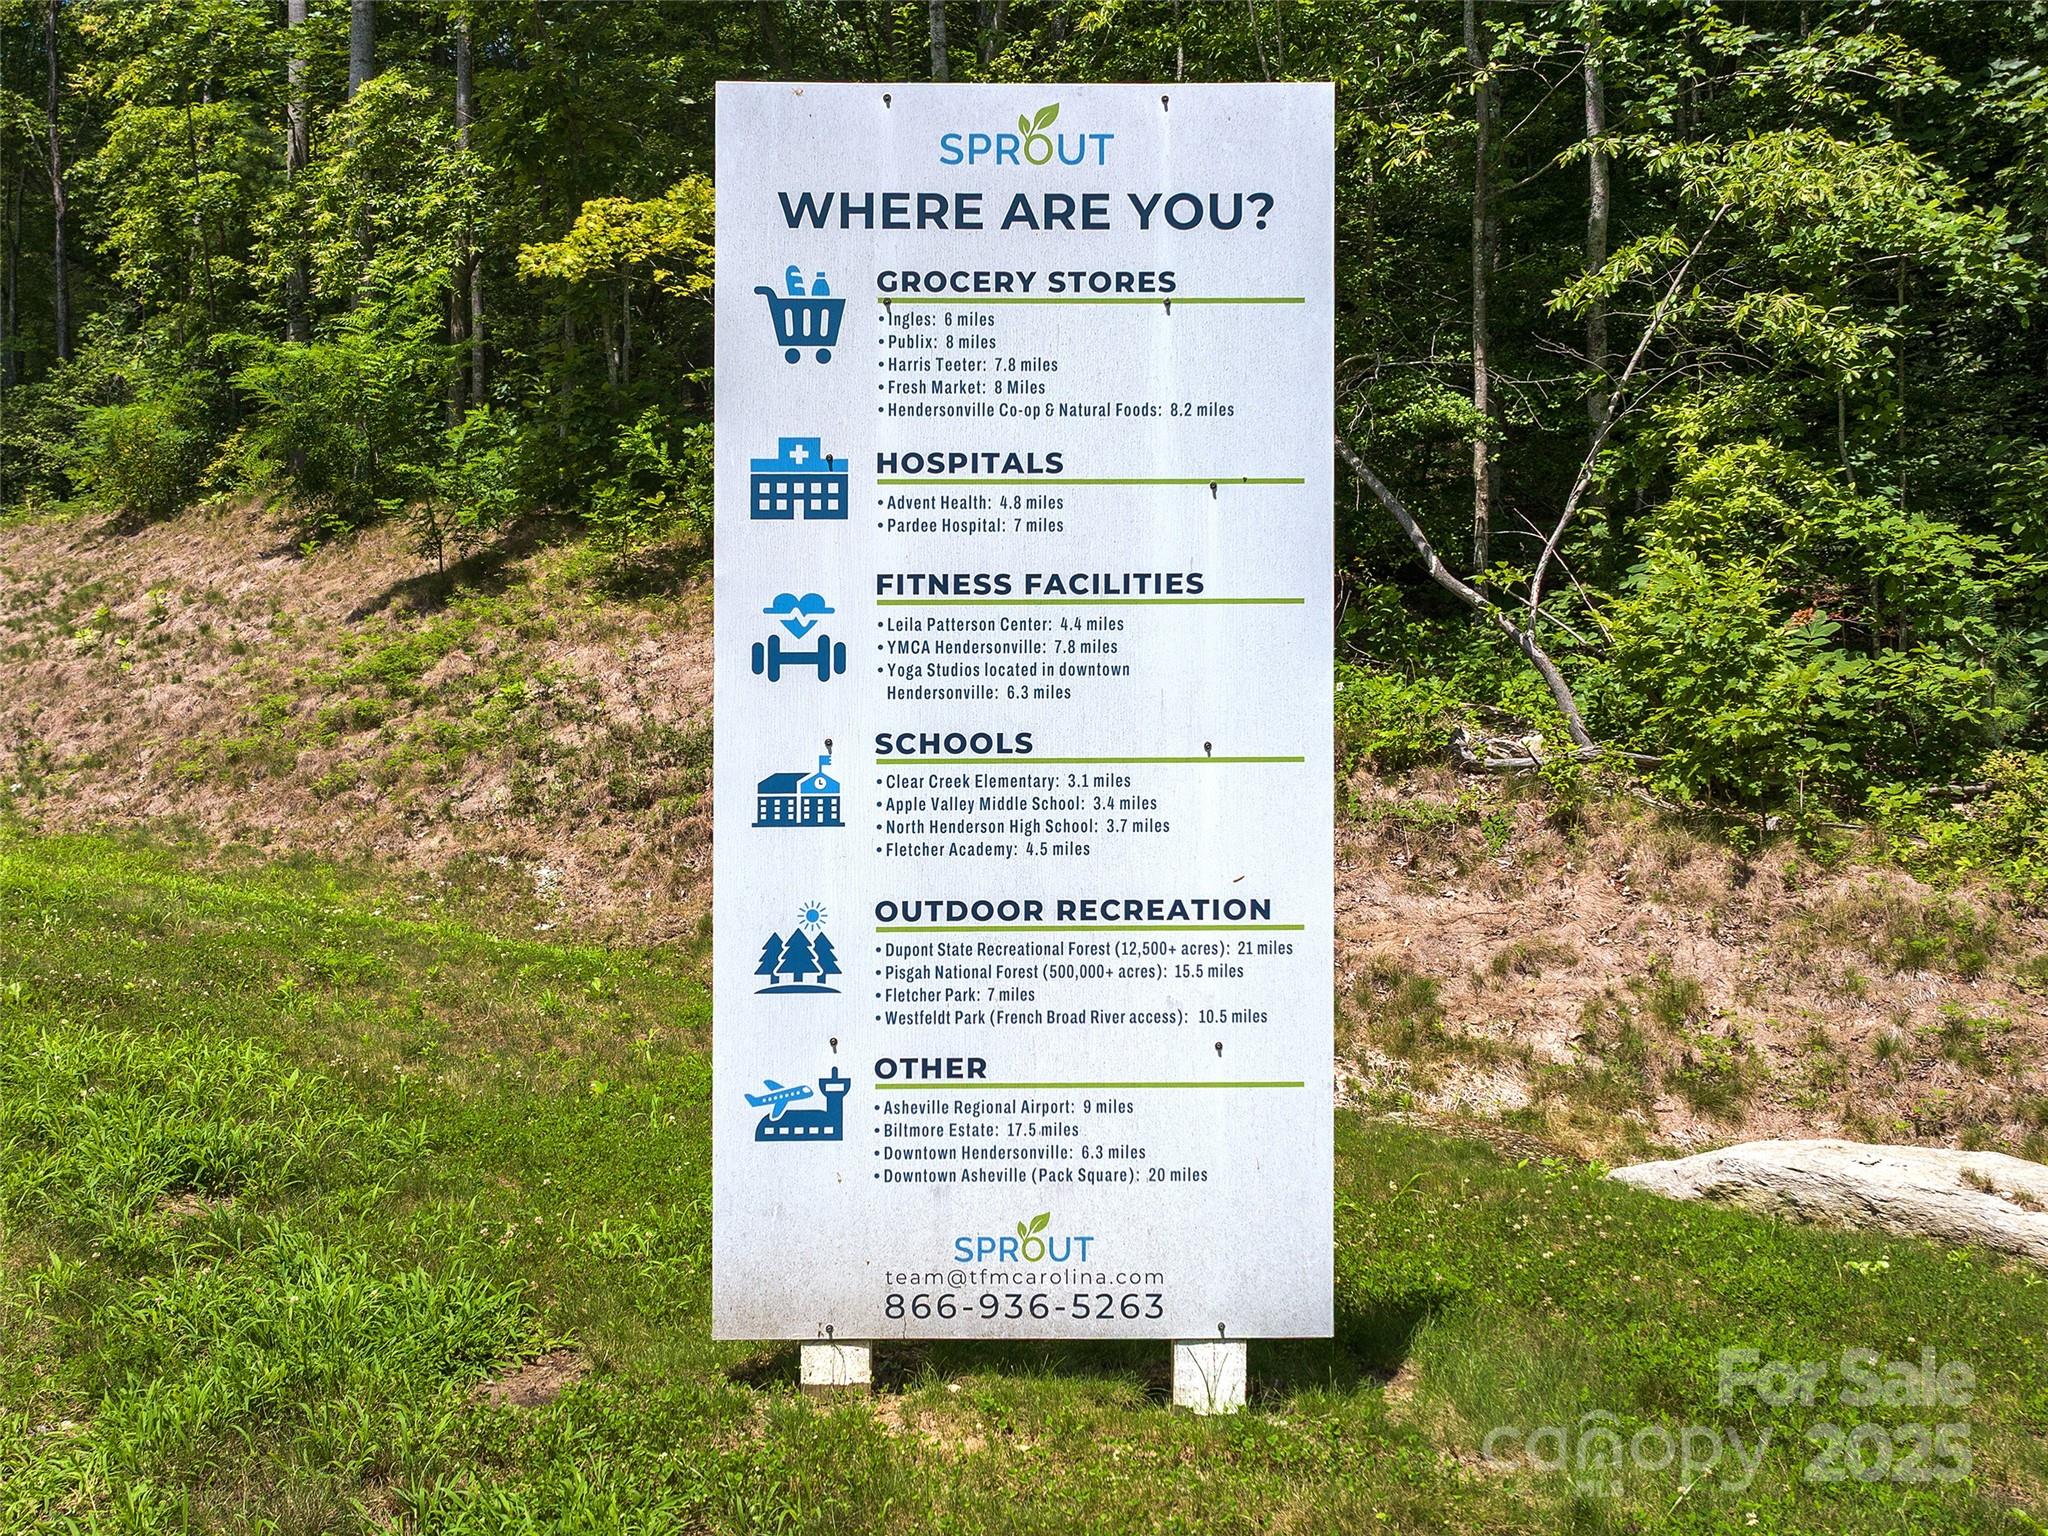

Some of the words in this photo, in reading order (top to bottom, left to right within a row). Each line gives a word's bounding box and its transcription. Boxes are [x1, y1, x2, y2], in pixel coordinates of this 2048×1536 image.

[939, 132, 1115, 166] SPROUT
[777, 191, 984, 230] WHERE
[999, 192, 1111, 231] ARE
[1126, 192, 1275, 231] YOU?
[876, 270, 1037, 293] GROCERY
[1048, 270, 1177, 294] STORES
[887, 311, 936, 330] Ingles:
[944, 311, 953, 327] 6
[957, 311, 995, 327] miles
[888, 333, 938, 349] Publix:
[946, 334, 954, 349] 8
[958, 333, 996, 350] miles
[888, 356, 931, 372] Harris
[935, 357, 987, 372] Teeter:
[994, 357, 1016, 372] 7.8
[1020, 356, 1058, 372] miles
[888, 379, 927, 395] Fresh
[931, 379, 986, 395] Market:
[994, 379, 1003, 395] 8
[1007, 379, 1046, 395] Miles
[888, 401, 995, 417] Hendersonville
[999, 402, 1041, 421] Co-op
[1045, 402, 1055, 417] &
[1059, 402, 1111, 417] Natural
[1115, 401, 1162, 417] Foods:
[1170, 402, 1192, 417] 8.2
[1196, 401, 1235, 417] miles
[876, 451, 1064, 475] HOSPITALS
[887, 494, 936, 510] Advent
[940, 494, 992, 510] Health:
[999, 495, 1022, 510] 4.8
[1026, 494, 1064, 510] miles
[887, 517, 937, 533] Pardee
[942, 517, 1006, 536] Hospital:
[1014, 518, 1022, 533] 7
[1026, 517, 1064, 533] miles
[876, 573, 1012, 596] FITNESS
[1025, 572, 1204, 596] FACILITIES
[887, 616, 923, 632] Leila
[927, 617, 995, 632] Patterson
[1000, 616, 1052, 632] Center:
[1060, 616, 1082, 631] 4.4
[1086, 616, 1124, 631] miles
[887, 639, 931, 655] YMCA
[935, 639, 1046, 655] Hendersonville:
[1054, 639, 1076, 654] 7.8
[1080, 638, 1118, 654] miles
[887, 662, 923, 681] Yoga
[927, 662, 980, 678] Studios
[984, 661, 1037, 677] located
[1042, 661, 1055, 677] in
[1059, 661, 1130, 677] downtown
[887, 684, 999, 700] Hendersonville:
[1007, 684, 1029, 700] 6.3
[1033, 684, 1071, 700] miles
[875, 732, 1033, 755] SCHOOLS
[886, 773, 925, 789] Clear
[928, 773, 970, 789] Creek
[975, 773, 1060, 792] Elementary:
[1067, 773, 1089, 788] 3.1
[1093, 772, 1131, 788] miles
[885, 796, 926, 815] Apple
[930, 796, 975, 815] Valley
[979, 795, 1028, 811] Middle
[1031, 795, 1085, 811] School:
[1093, 795, 1115, 811] 3.4
[1119, 795, 1157, 810] miles
[886, 819, 925, 834] North
[929, 818, 1005, 834] Henderson
[1009, 818, 1041, 837] High
[1045, 818, 1098, 834] School:
[1106, 818, 1128, 833] 3.7
[1132, 817, 1170, 833] miles
[886, 841, 945, 857] Fletcher
[948, 841, 1018, 860] Academy:
[1025, 841, 1048, 856] 4.5
[1052, 840, 1090, 856] miles
[874, 899, 1044, 923] OUTDOOR
[1056, 898, 1271, 922] RECREATION
[885, 942, 934, 961] Dupont
[937, 942, 973, 957] State
[977, 941, 1064, 957] Recreational
[1068, 941, 1111, 956] Forest
[1114, 940, 1177, 959] (12,500+
[1181, 940, 1230, 958] acres):
[1237, 940, 1253, 955] 21
[1257, 940, 1293, 955] miles
[885, 964, 931, 983] Pisgah
[935, 964, 992, 980] National
[996, 964, 1039, 979] Forest
[1042, 963, 1114, 982] (500,000+
[1118, 963, 1167, 981] acres):
[1175, 963, 1204, 979] 15.5
[1207, 963, 1244, 978] miles
[885, 987, 942, 1003] Fletcher
[945, 987, 980, 1002] Park:
[987, 987, 995, 1002] 7
[999, 986, 1035, 1002] miles
[884, 1009, 951, 1026] Westfeldt
[954, 1009, 986, 1025] Park
[989, 1009, 1043, 1028] (French
[1046, 1009, 1086, 1025] Broad
[1090, 1009, 1126, 1025] River
[1129, 1008, 1188, 1027] access):
[1199, 1009, 1228, 1024] 10.5
[1231, 1008, 1268, 1024] miles
[874, 1057, 987, 1080] OTHER
[883, 1099, 949, 1115] Asheville
[954, 1099, 1016, 1118] Regional
[1020, 1098, 1075, 1118] Airport:
[1083, 1099, 1092, 1114] 9
[1096, 1098, 1134, 1114] miles
[884, 1122, 944, 1138] Biltmore
[949, 1122, 999, 1137] Estate:
[1007, 1122, 1036, 1137] 17.5
[1041, 1121, 1079, 1137] miles
[884, 1146, 957, 1161] Downtown
[961, 1144, 1073, 1160] Hendersonville:
[1081, 1144, 1104, 1160] 6.3
[1108, 1144, 1146, 1160] miles
[884, 1168, 957, 1183] Downtown
[961, 1167, 1027, 1183] Asheville
[1031, 1167, 1073, 1185] (Pack
[1077, 1167, 1140, 1186] Square):
[1148, 1167, 1166, 1182] 20
[1170, 1166, 1208, 1182] miles
[954, 1234, 1094, 1263] SPROUT
[885, 1268, 1164, 1289] team@tfmcarolina.com
[884, 1292, 1164, 1322] 866-936-5263
